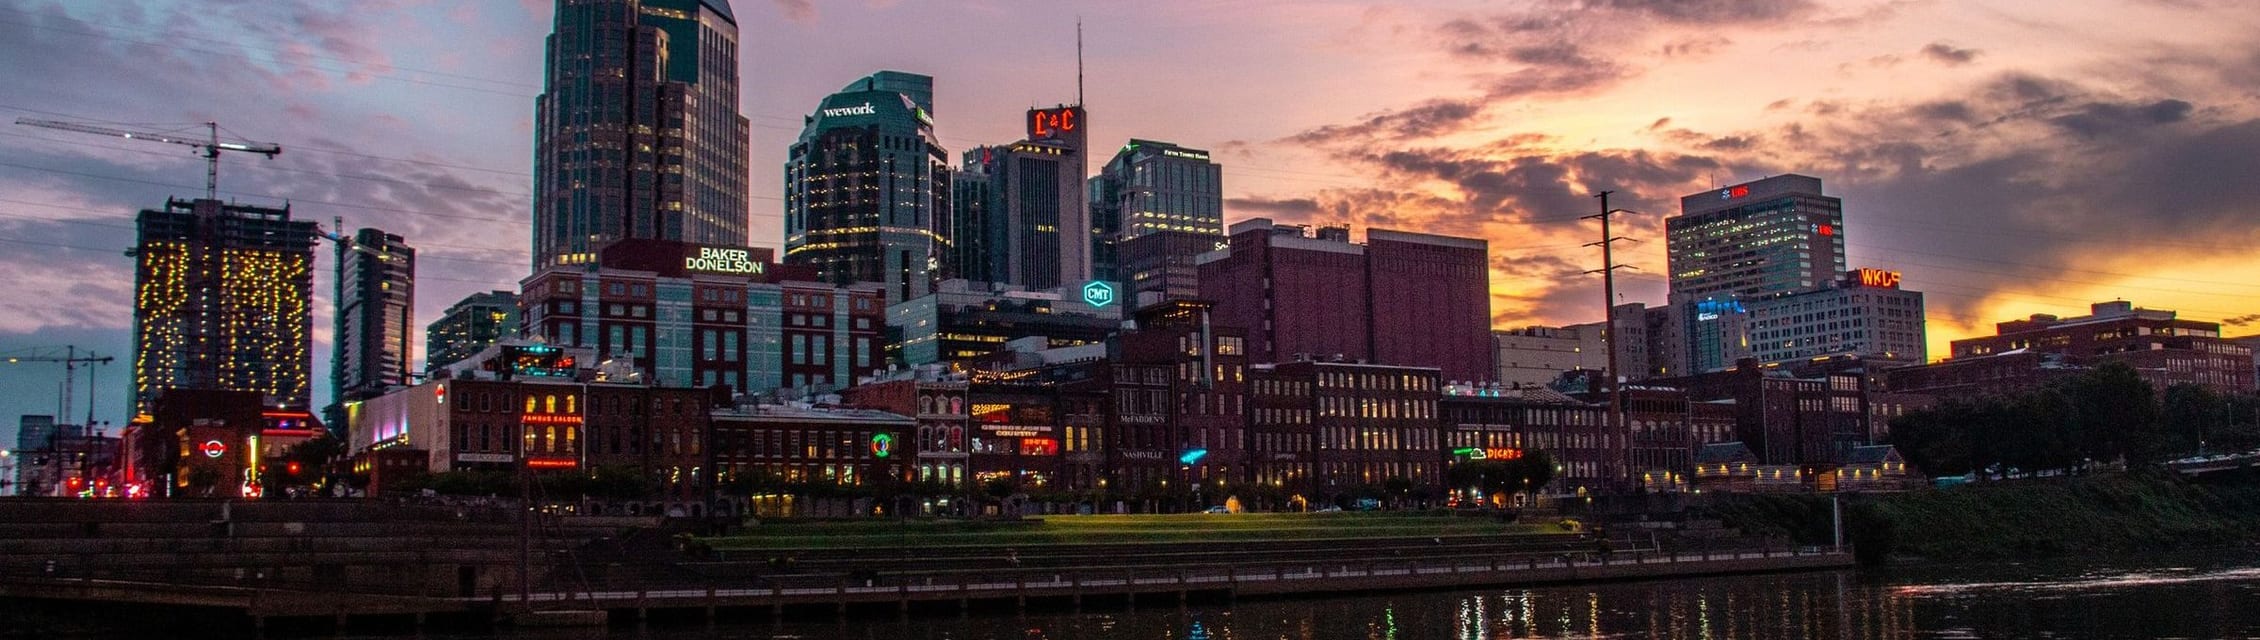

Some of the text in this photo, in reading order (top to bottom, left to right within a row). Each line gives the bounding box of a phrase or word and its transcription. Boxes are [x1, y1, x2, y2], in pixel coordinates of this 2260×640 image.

[823, 102, 875, 117] wework
[701, 247, 748, 262] BAKER
[686, 257, 763, 273] DONELSON
[1088, 288, 1109, 300] CMT
[554, 415, 583, 423] SALOON
[1123, 451, 1163, 459] NASHVILLE
